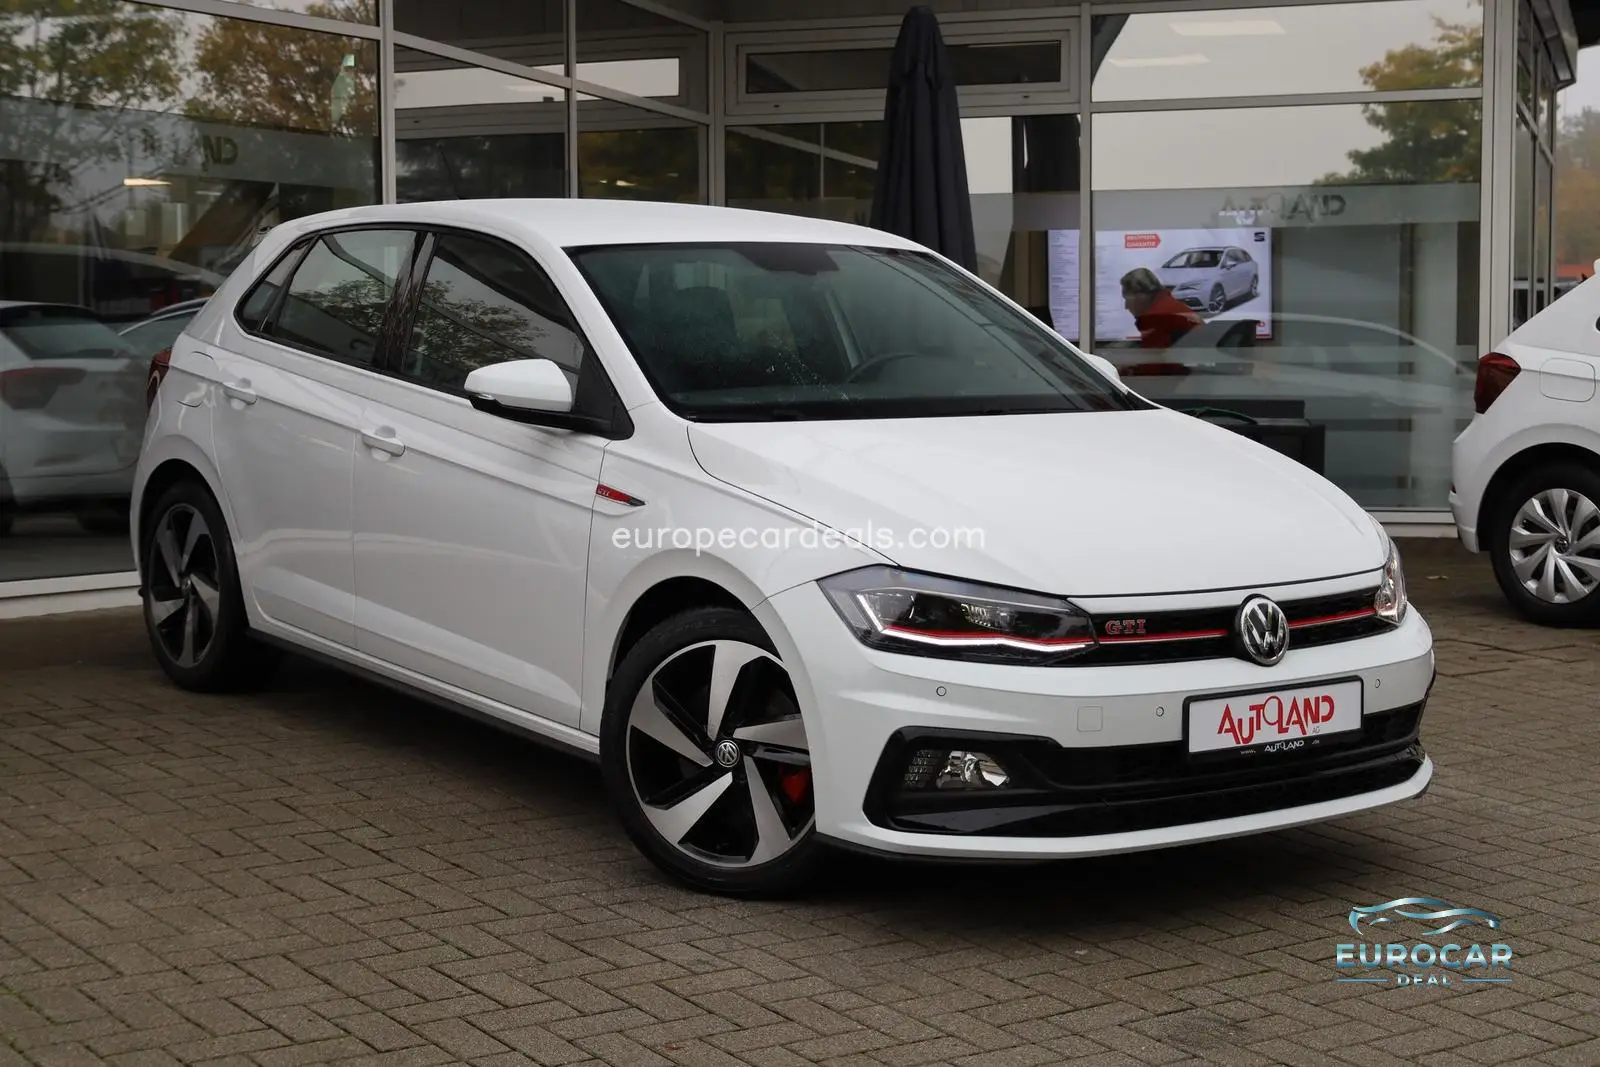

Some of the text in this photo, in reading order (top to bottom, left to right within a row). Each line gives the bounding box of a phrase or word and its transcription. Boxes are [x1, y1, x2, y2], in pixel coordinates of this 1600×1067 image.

[1105, 619, 1146, 634] GTI
[1217, 695, 1335, 745] AUTOLAND
[1312, 725, 1321, 734] AG
[1264, 740, 1305, 752] AUTOLAND
